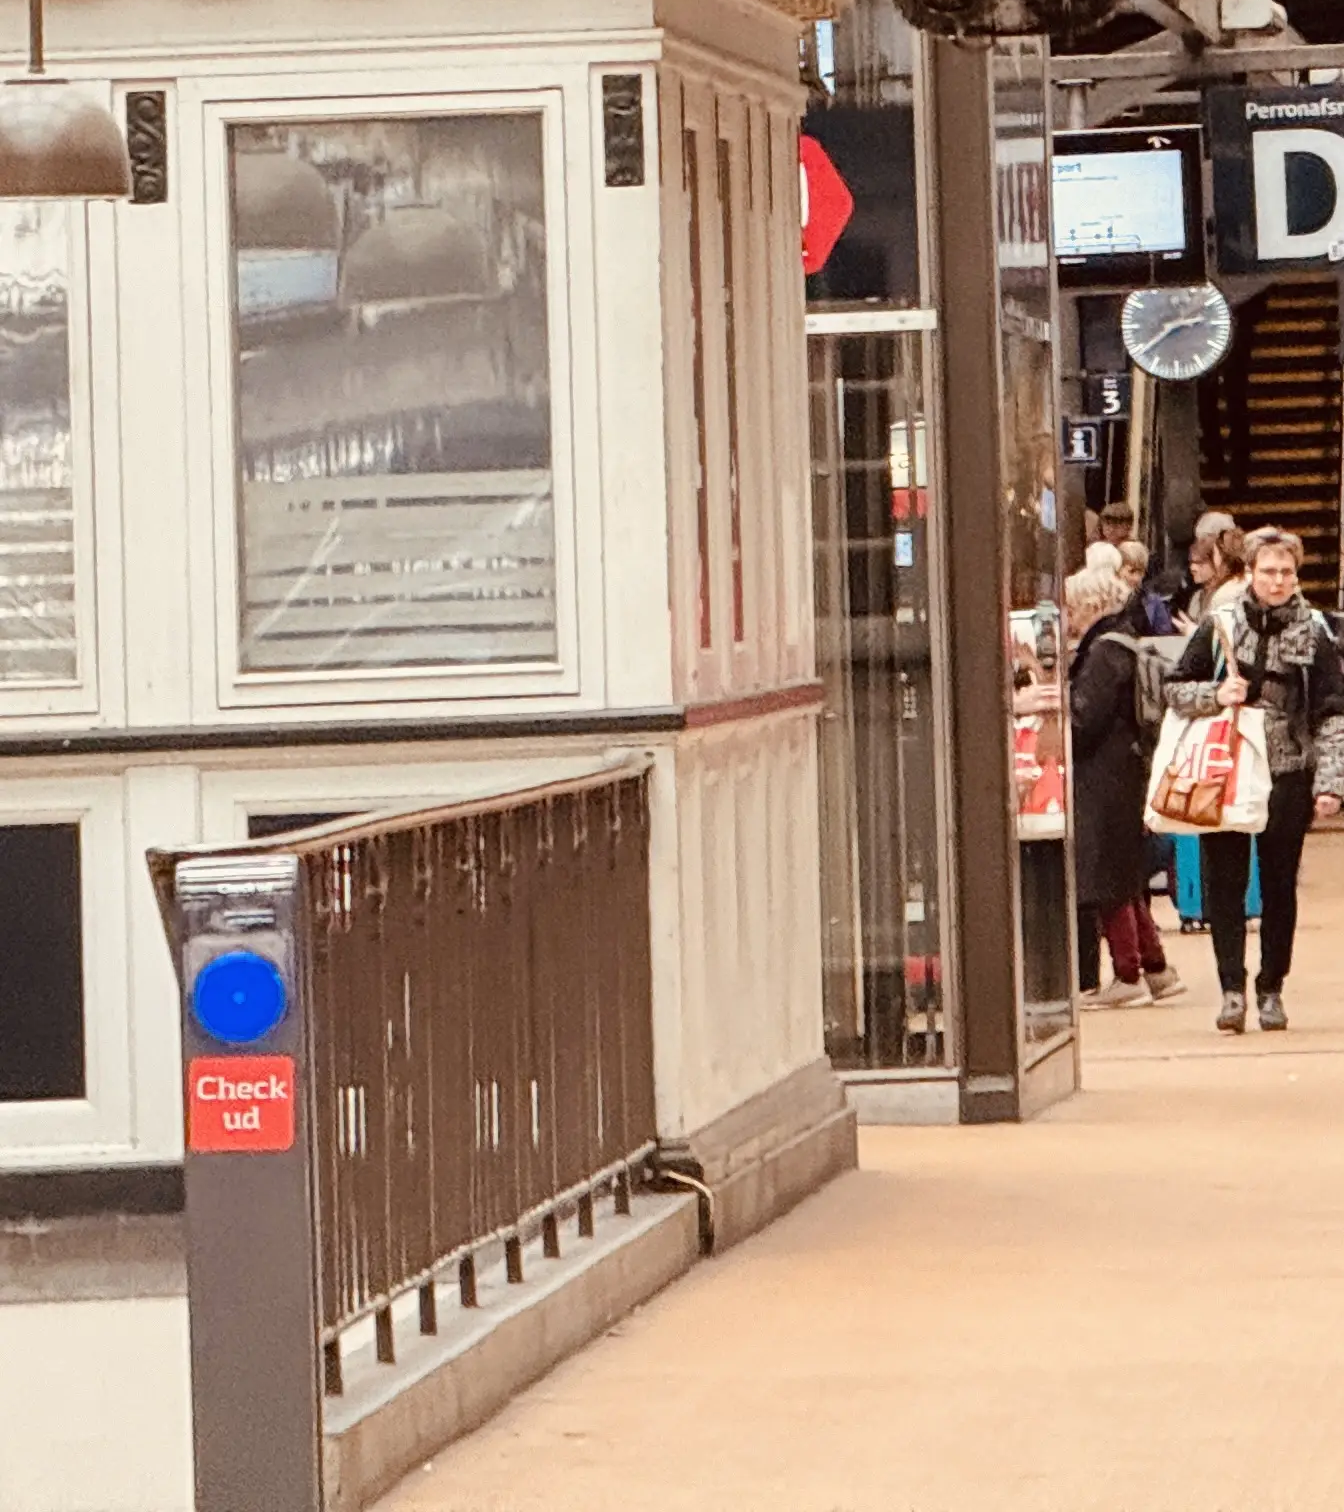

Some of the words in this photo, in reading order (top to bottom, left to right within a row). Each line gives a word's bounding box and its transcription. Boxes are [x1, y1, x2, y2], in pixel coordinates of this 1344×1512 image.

[1102, 390, 1121, 414] 3
[196, 1075, 288, 1102] Check
[223, 1106, 260, 1131] ud
